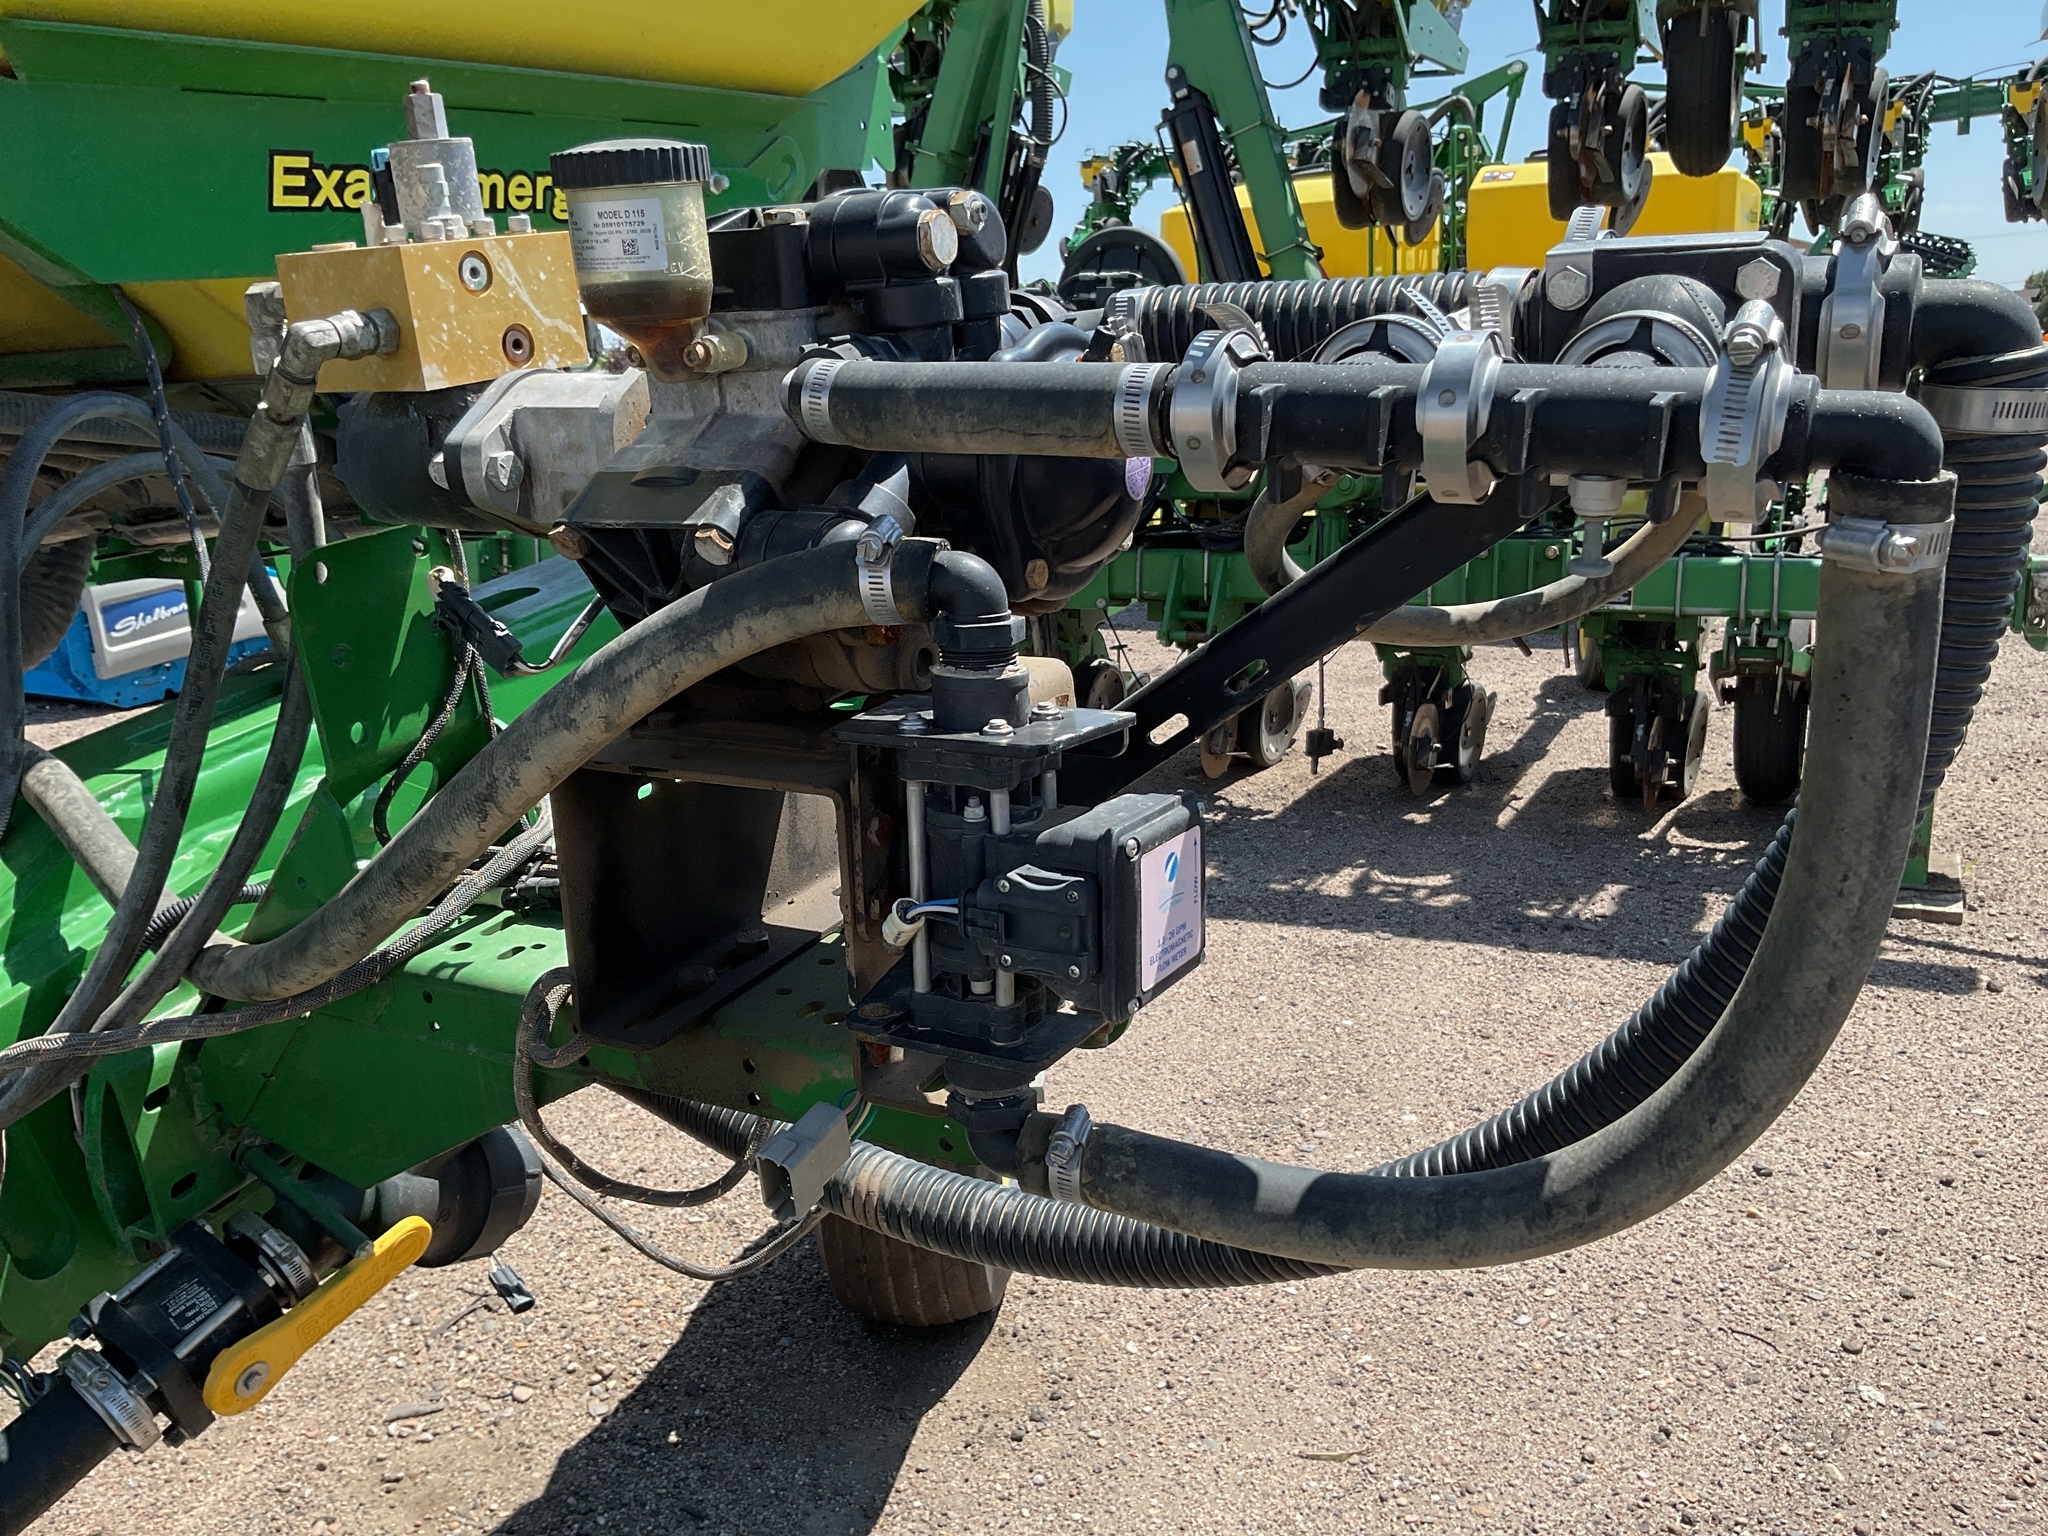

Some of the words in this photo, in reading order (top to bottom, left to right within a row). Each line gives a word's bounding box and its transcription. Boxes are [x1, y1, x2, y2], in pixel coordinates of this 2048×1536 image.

[272, 155, 569, 220] Examerg
[597, 210, 623, 220] MODEL
[624, 210, 630, 218] D
[632, 209, 645, 218] 115
[196, 638, 215, 667] 3500
[1176, 922, 1186, 935] GPM
[1150, 930, 1194, 966] ELECTROMAGNETIC
[1157, 958, 1171, 973] FLOW
[1172, 946, 1187, 962] METER
